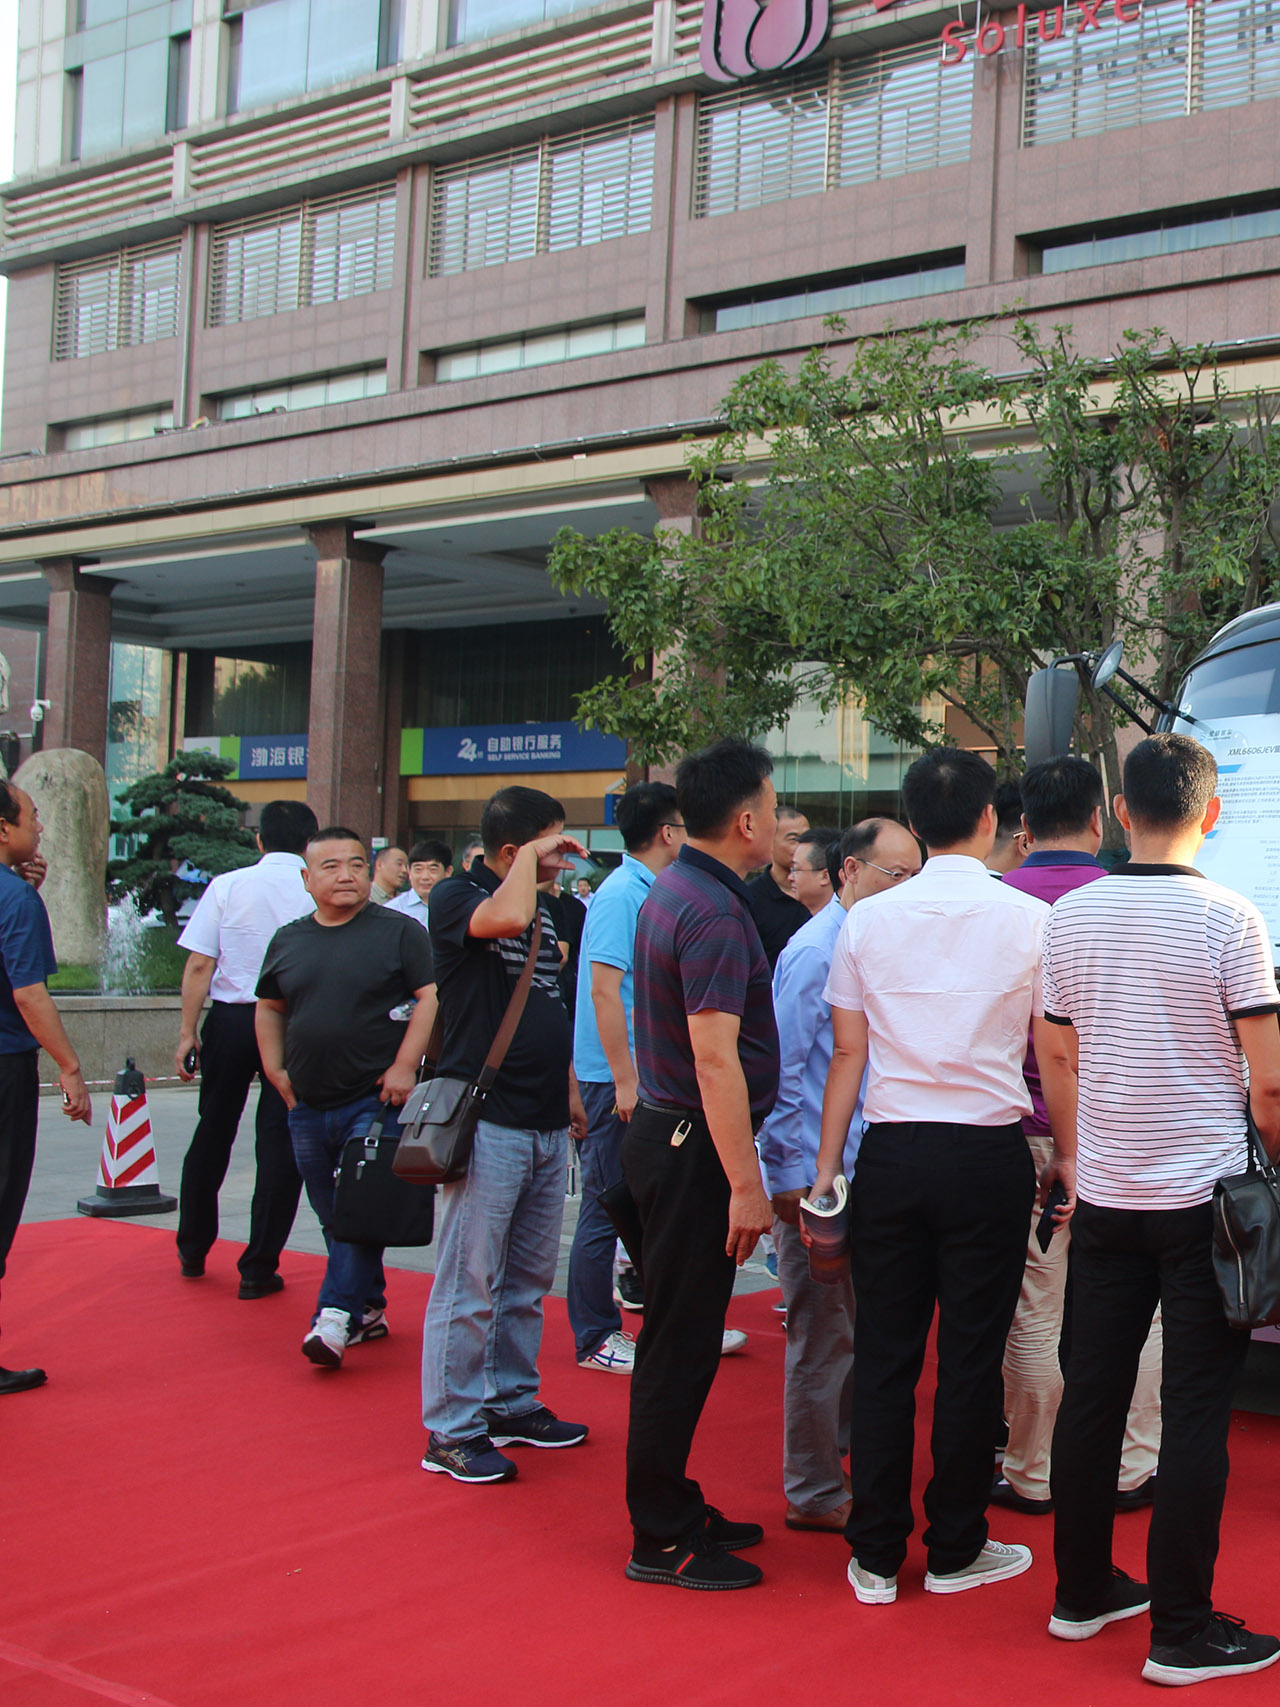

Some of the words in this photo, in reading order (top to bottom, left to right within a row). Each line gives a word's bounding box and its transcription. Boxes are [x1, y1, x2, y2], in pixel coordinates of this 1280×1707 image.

[457, 737, 477, 762] 24
[487, 734, 562, 752] 自助银行服务
[251, 746, 309, 767] 渤海银
[487, 753, 501, 762] SELF
[503, 752, 530, 761] SERVICE
[531, 750, 561, 760] BANKING
